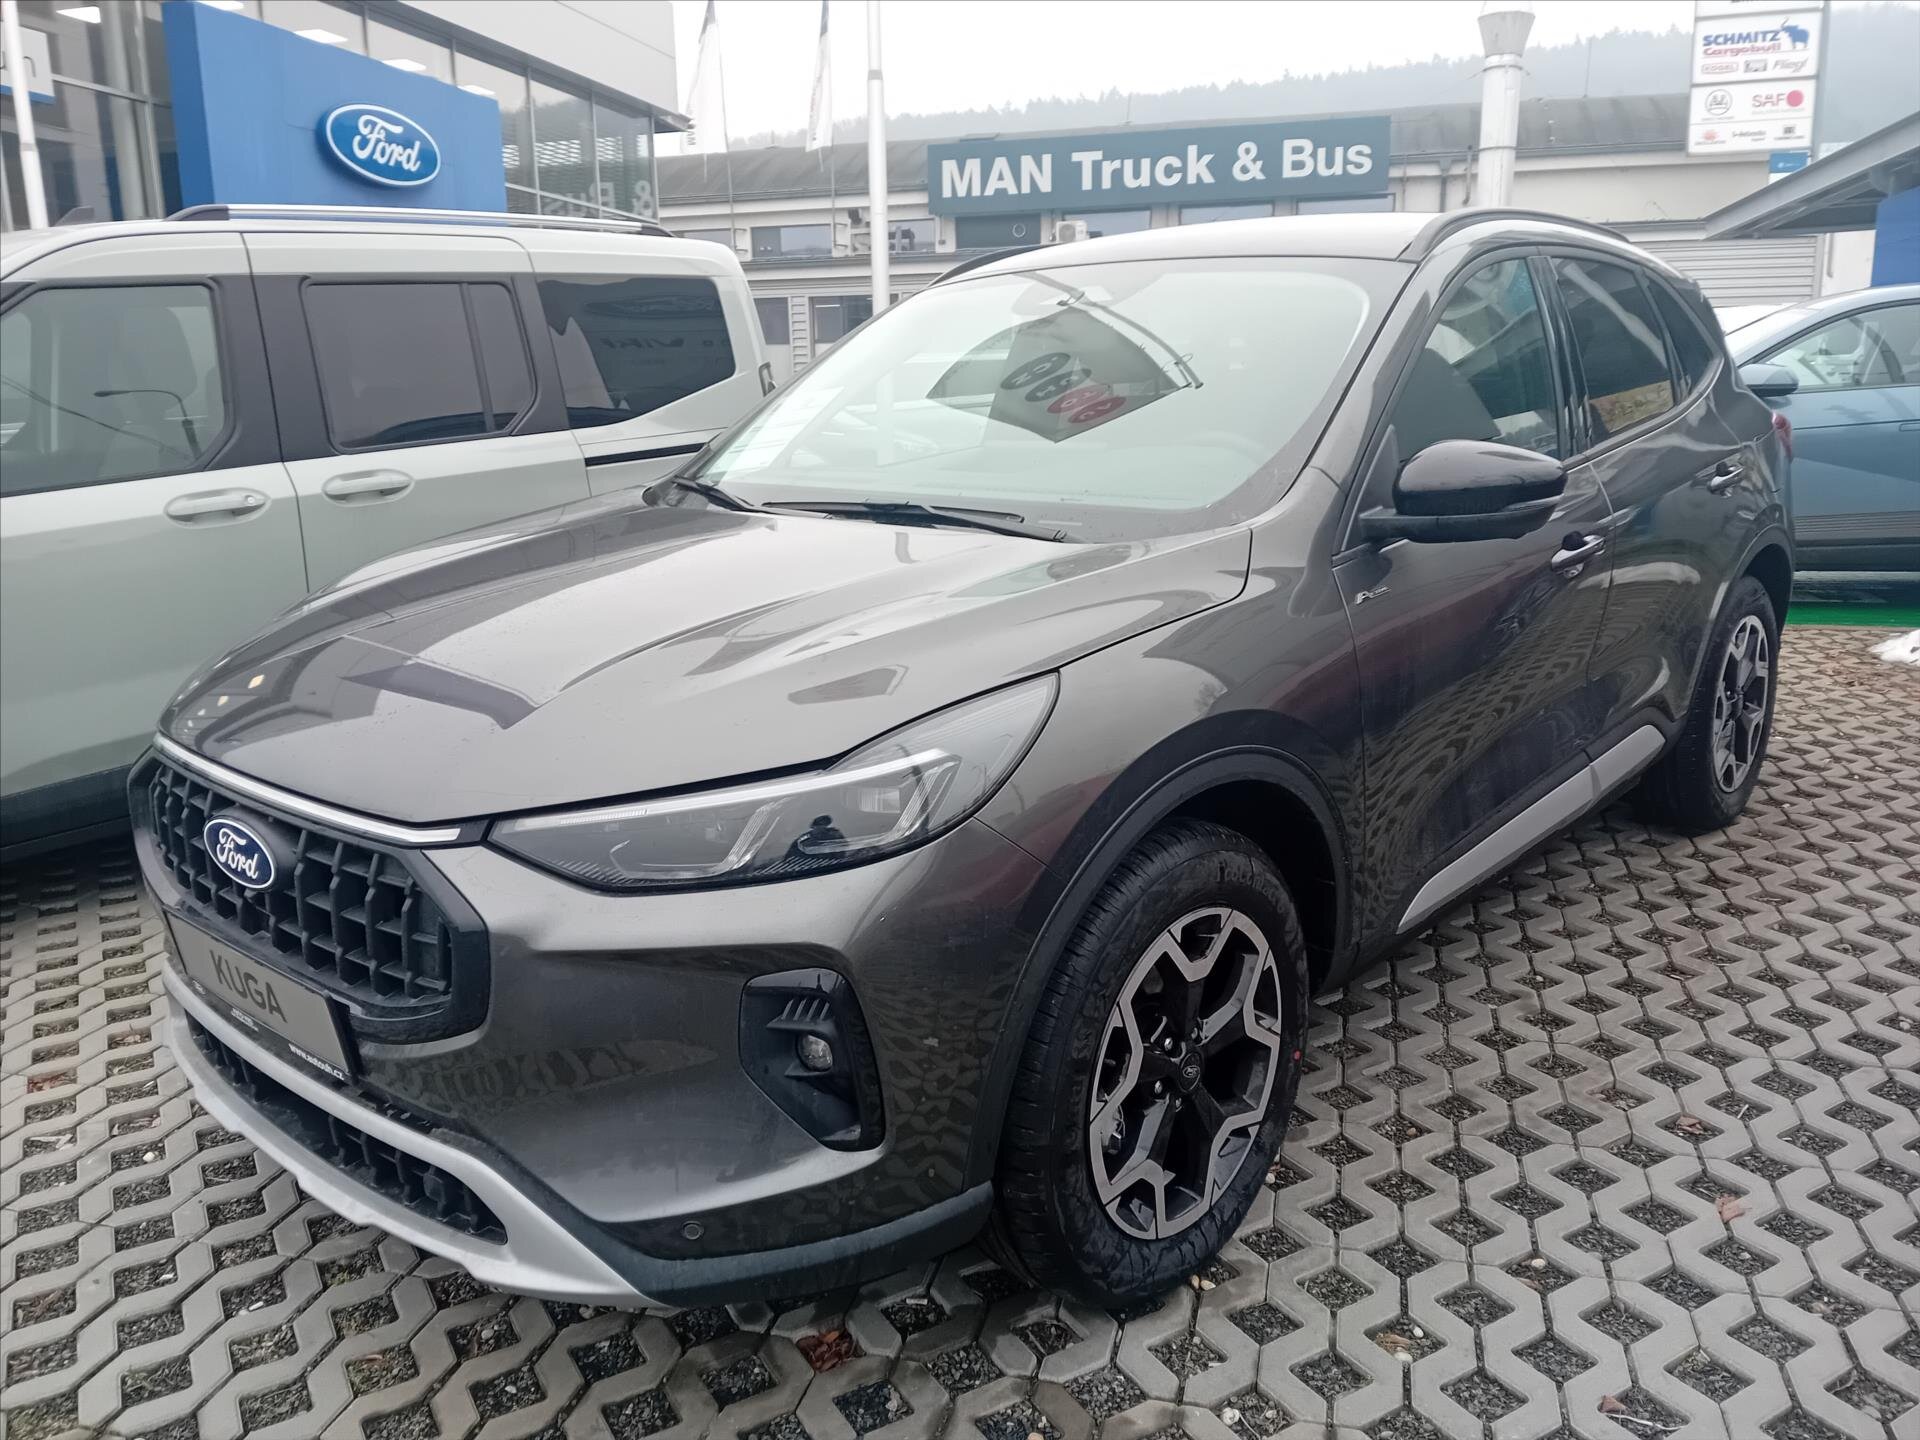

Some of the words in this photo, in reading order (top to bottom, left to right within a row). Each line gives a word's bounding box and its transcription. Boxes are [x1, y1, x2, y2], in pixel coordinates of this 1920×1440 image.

[1702, 29, 1781, 47] SCHMITZ
[1752, 92, 1786, 108] SAF
[352, 114, 421, 171] Ford
[942, 153, 1052, 198] MAN
[1071, 144, 1216, 191] Truck
[1232, 141, 1266, 182] &
[1282, 138, 1373, 178] Bus
[216, 828, 259, 879] Ford
[209, 949, 288, 1023] KUGA
